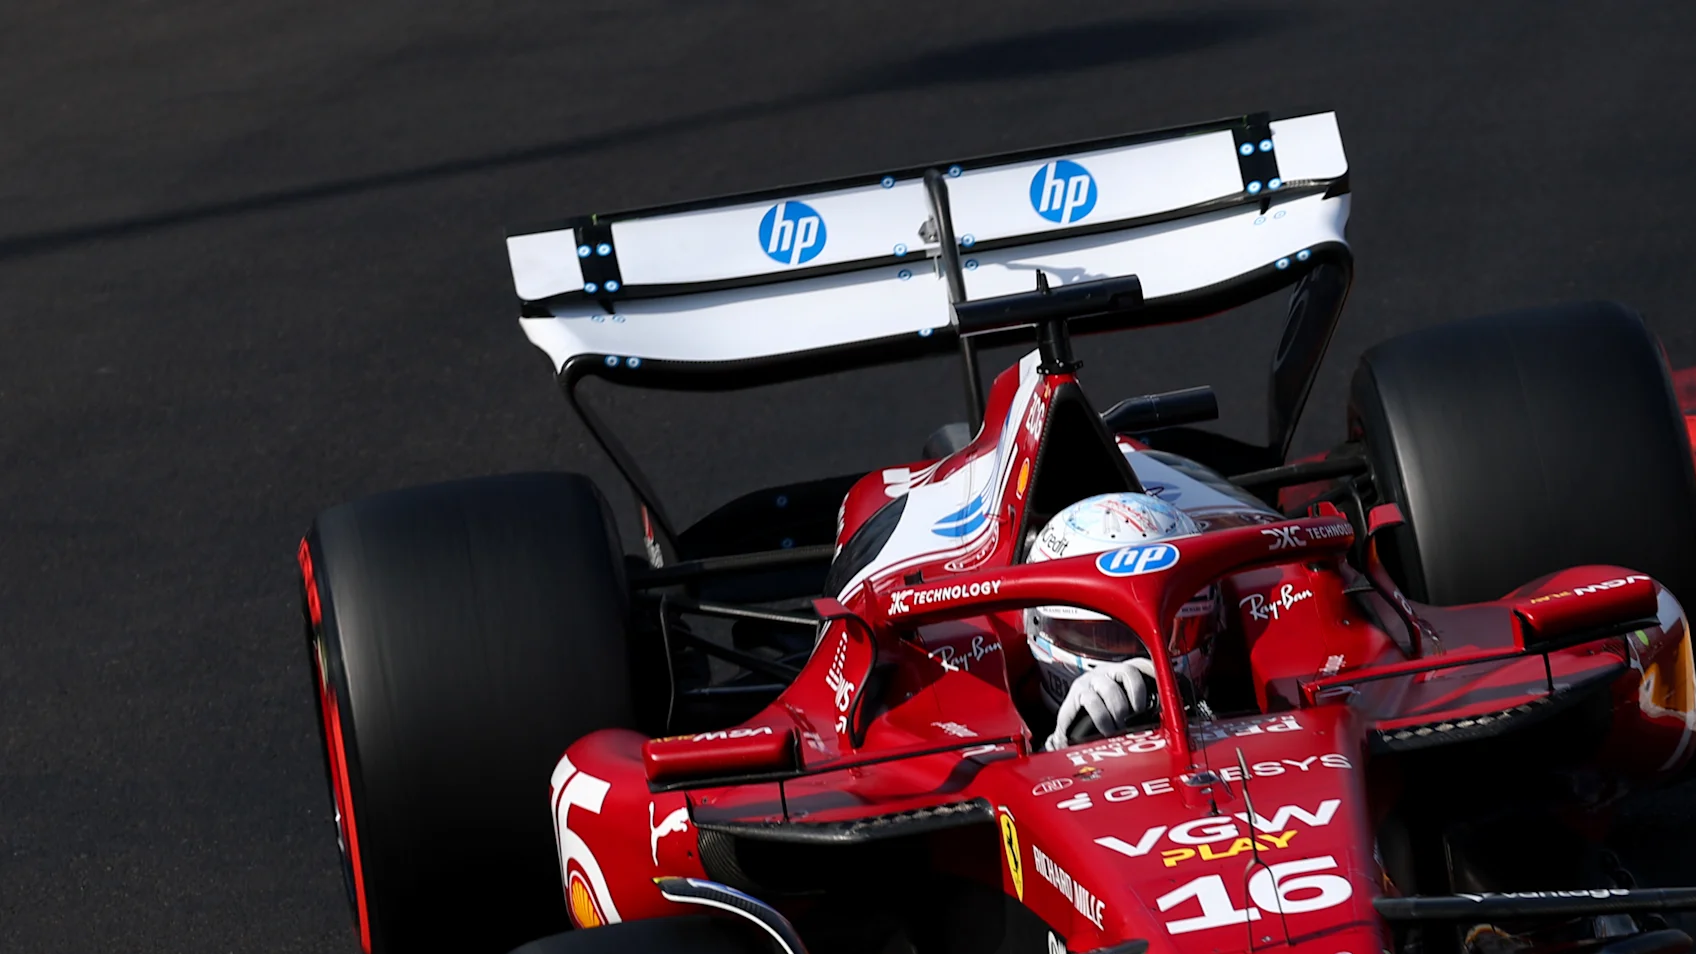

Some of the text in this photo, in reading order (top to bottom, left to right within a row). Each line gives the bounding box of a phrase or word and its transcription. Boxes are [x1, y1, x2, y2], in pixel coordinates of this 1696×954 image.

[1109, 546, 1167, 573] hp
[913, 580, 1001, 605] TECHNOLOGY
[1094, 799, 1341, 858] VGW
[1162, 830, 1298, 868] PLAY
[1032, 844, 1106, 931] RICHARD MILLE
[1156, 855, 1353, 935] 16
